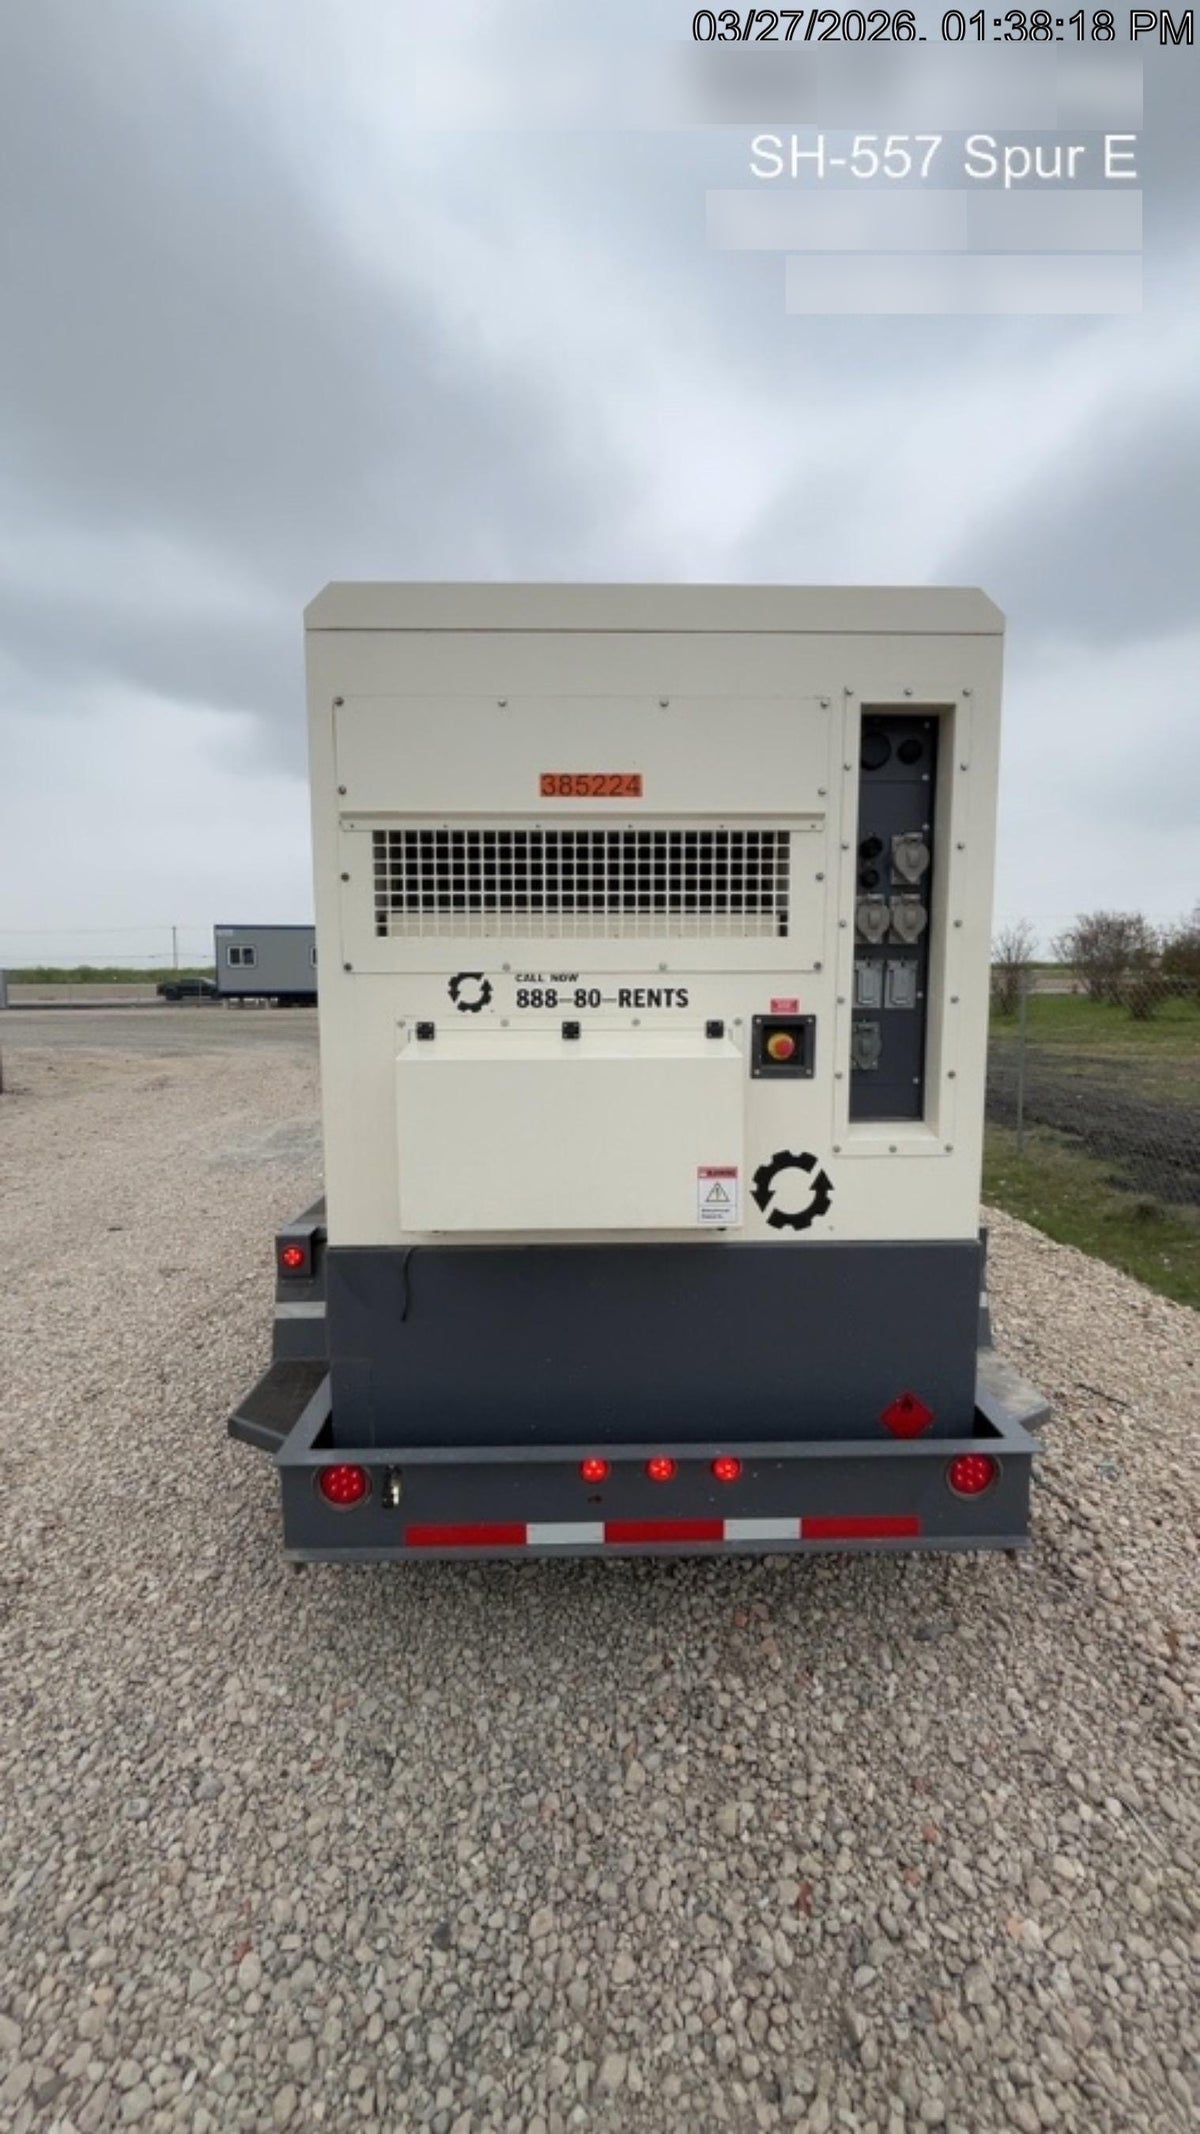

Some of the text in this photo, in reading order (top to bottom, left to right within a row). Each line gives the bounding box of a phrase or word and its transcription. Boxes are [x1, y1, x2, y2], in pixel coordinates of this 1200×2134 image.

[541, 774, 642, 796] 385224
[515, 972, 579, 982] CALL NOW
[516, 988, 689, 1008] 888-80-RENTS
